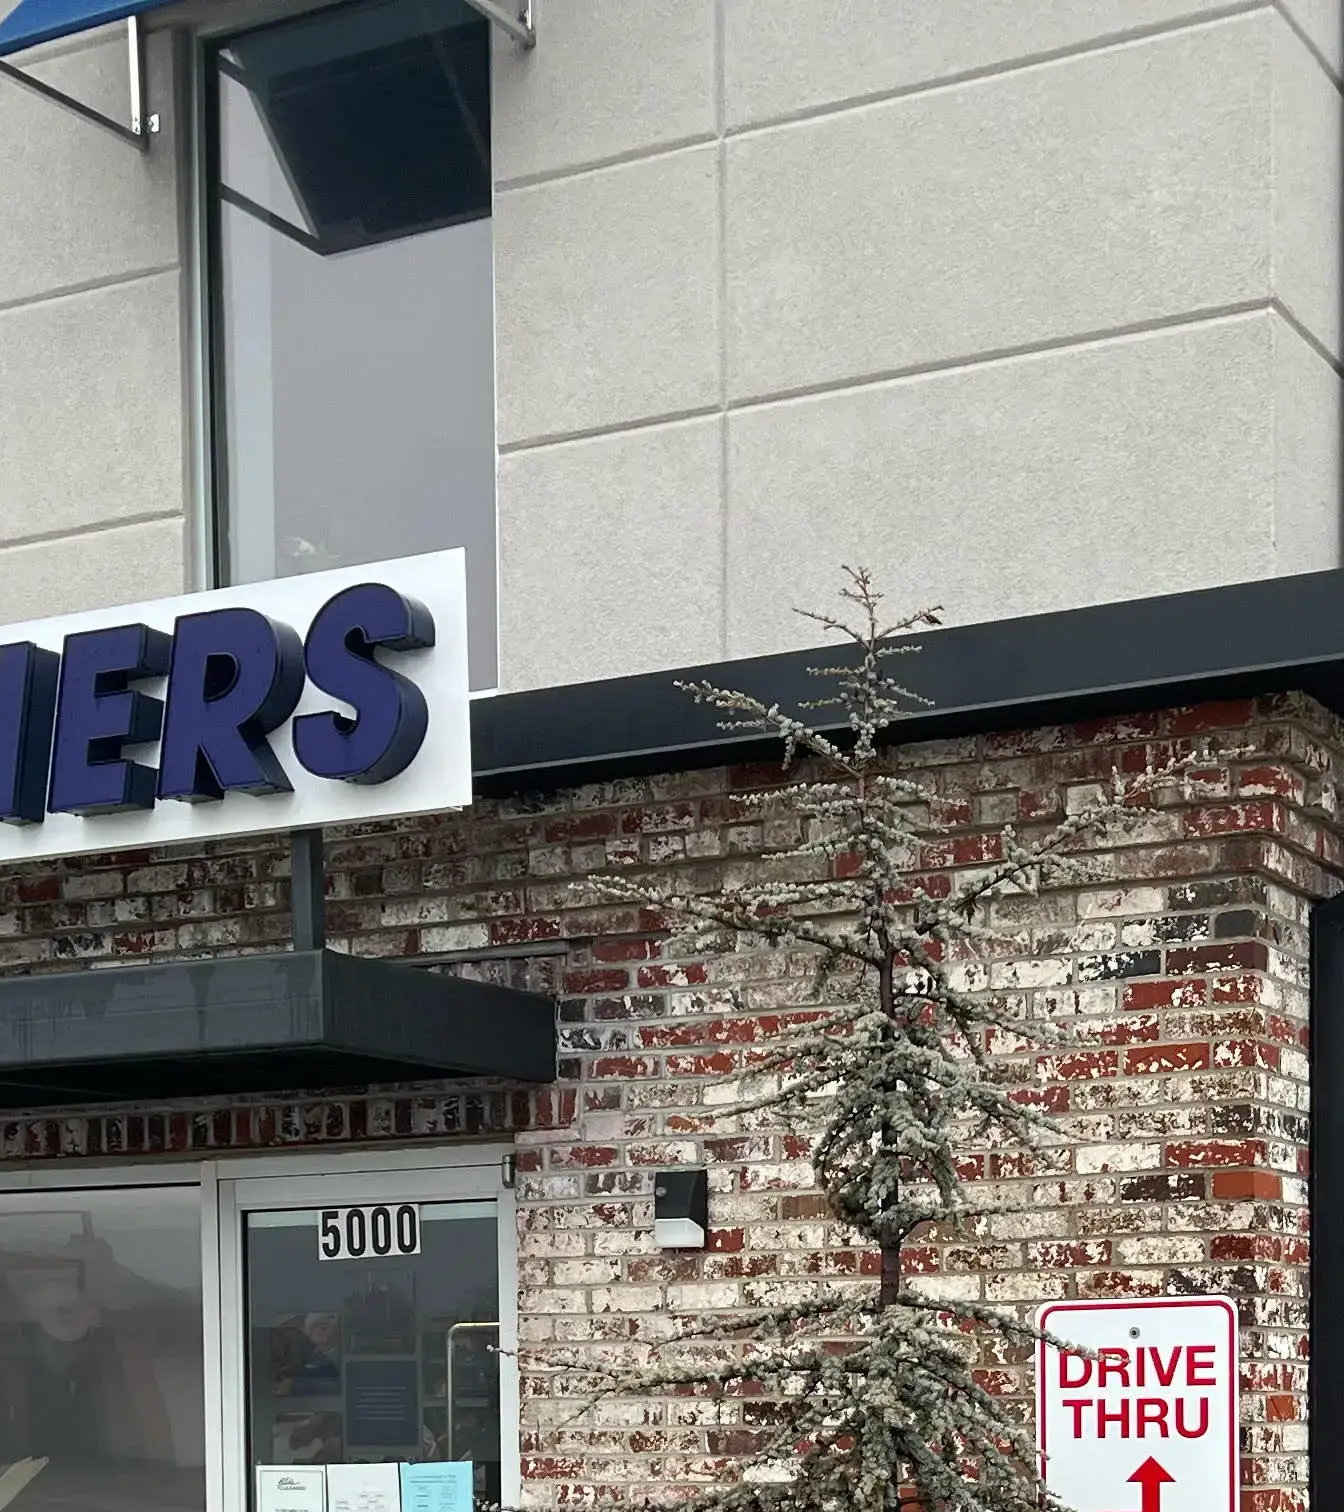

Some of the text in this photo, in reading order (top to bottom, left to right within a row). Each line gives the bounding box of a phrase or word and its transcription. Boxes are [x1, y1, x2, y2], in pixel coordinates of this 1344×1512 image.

[321, 1204, 417, 1258] 5000
[1059, 1344, 1216, 1388] DRIVE
[1062, 1397, 1208, 1438] THRU
